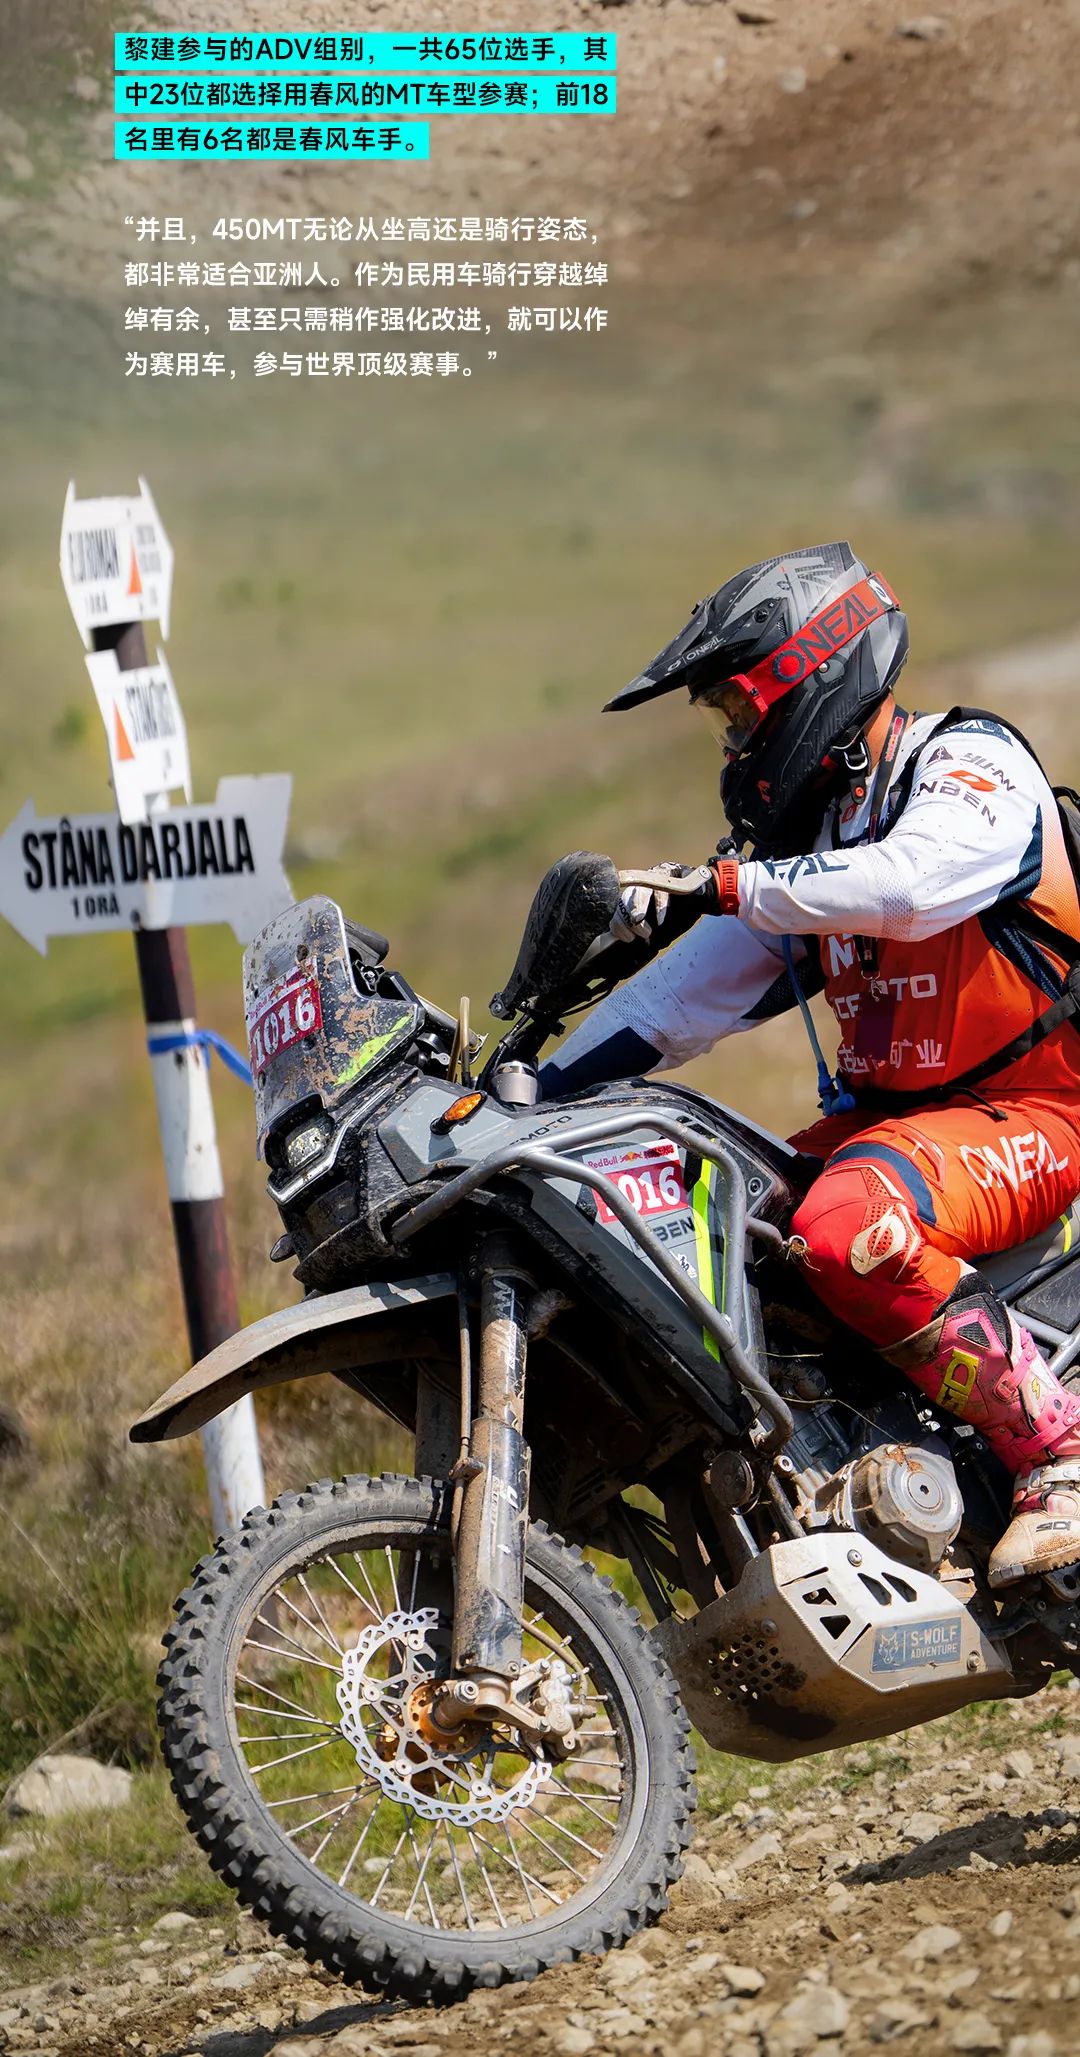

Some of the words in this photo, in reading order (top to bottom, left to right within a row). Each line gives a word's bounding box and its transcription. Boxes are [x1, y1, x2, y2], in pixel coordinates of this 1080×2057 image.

[911, 780, 997, 827] NBEN
[253, 988, 316, 1069] 1016
[606, 1165, 681, 1217] 016
[910, 1624, 958, 1647] S-WOLF
[910, 1643, 958, 1660] ADVENTURE
